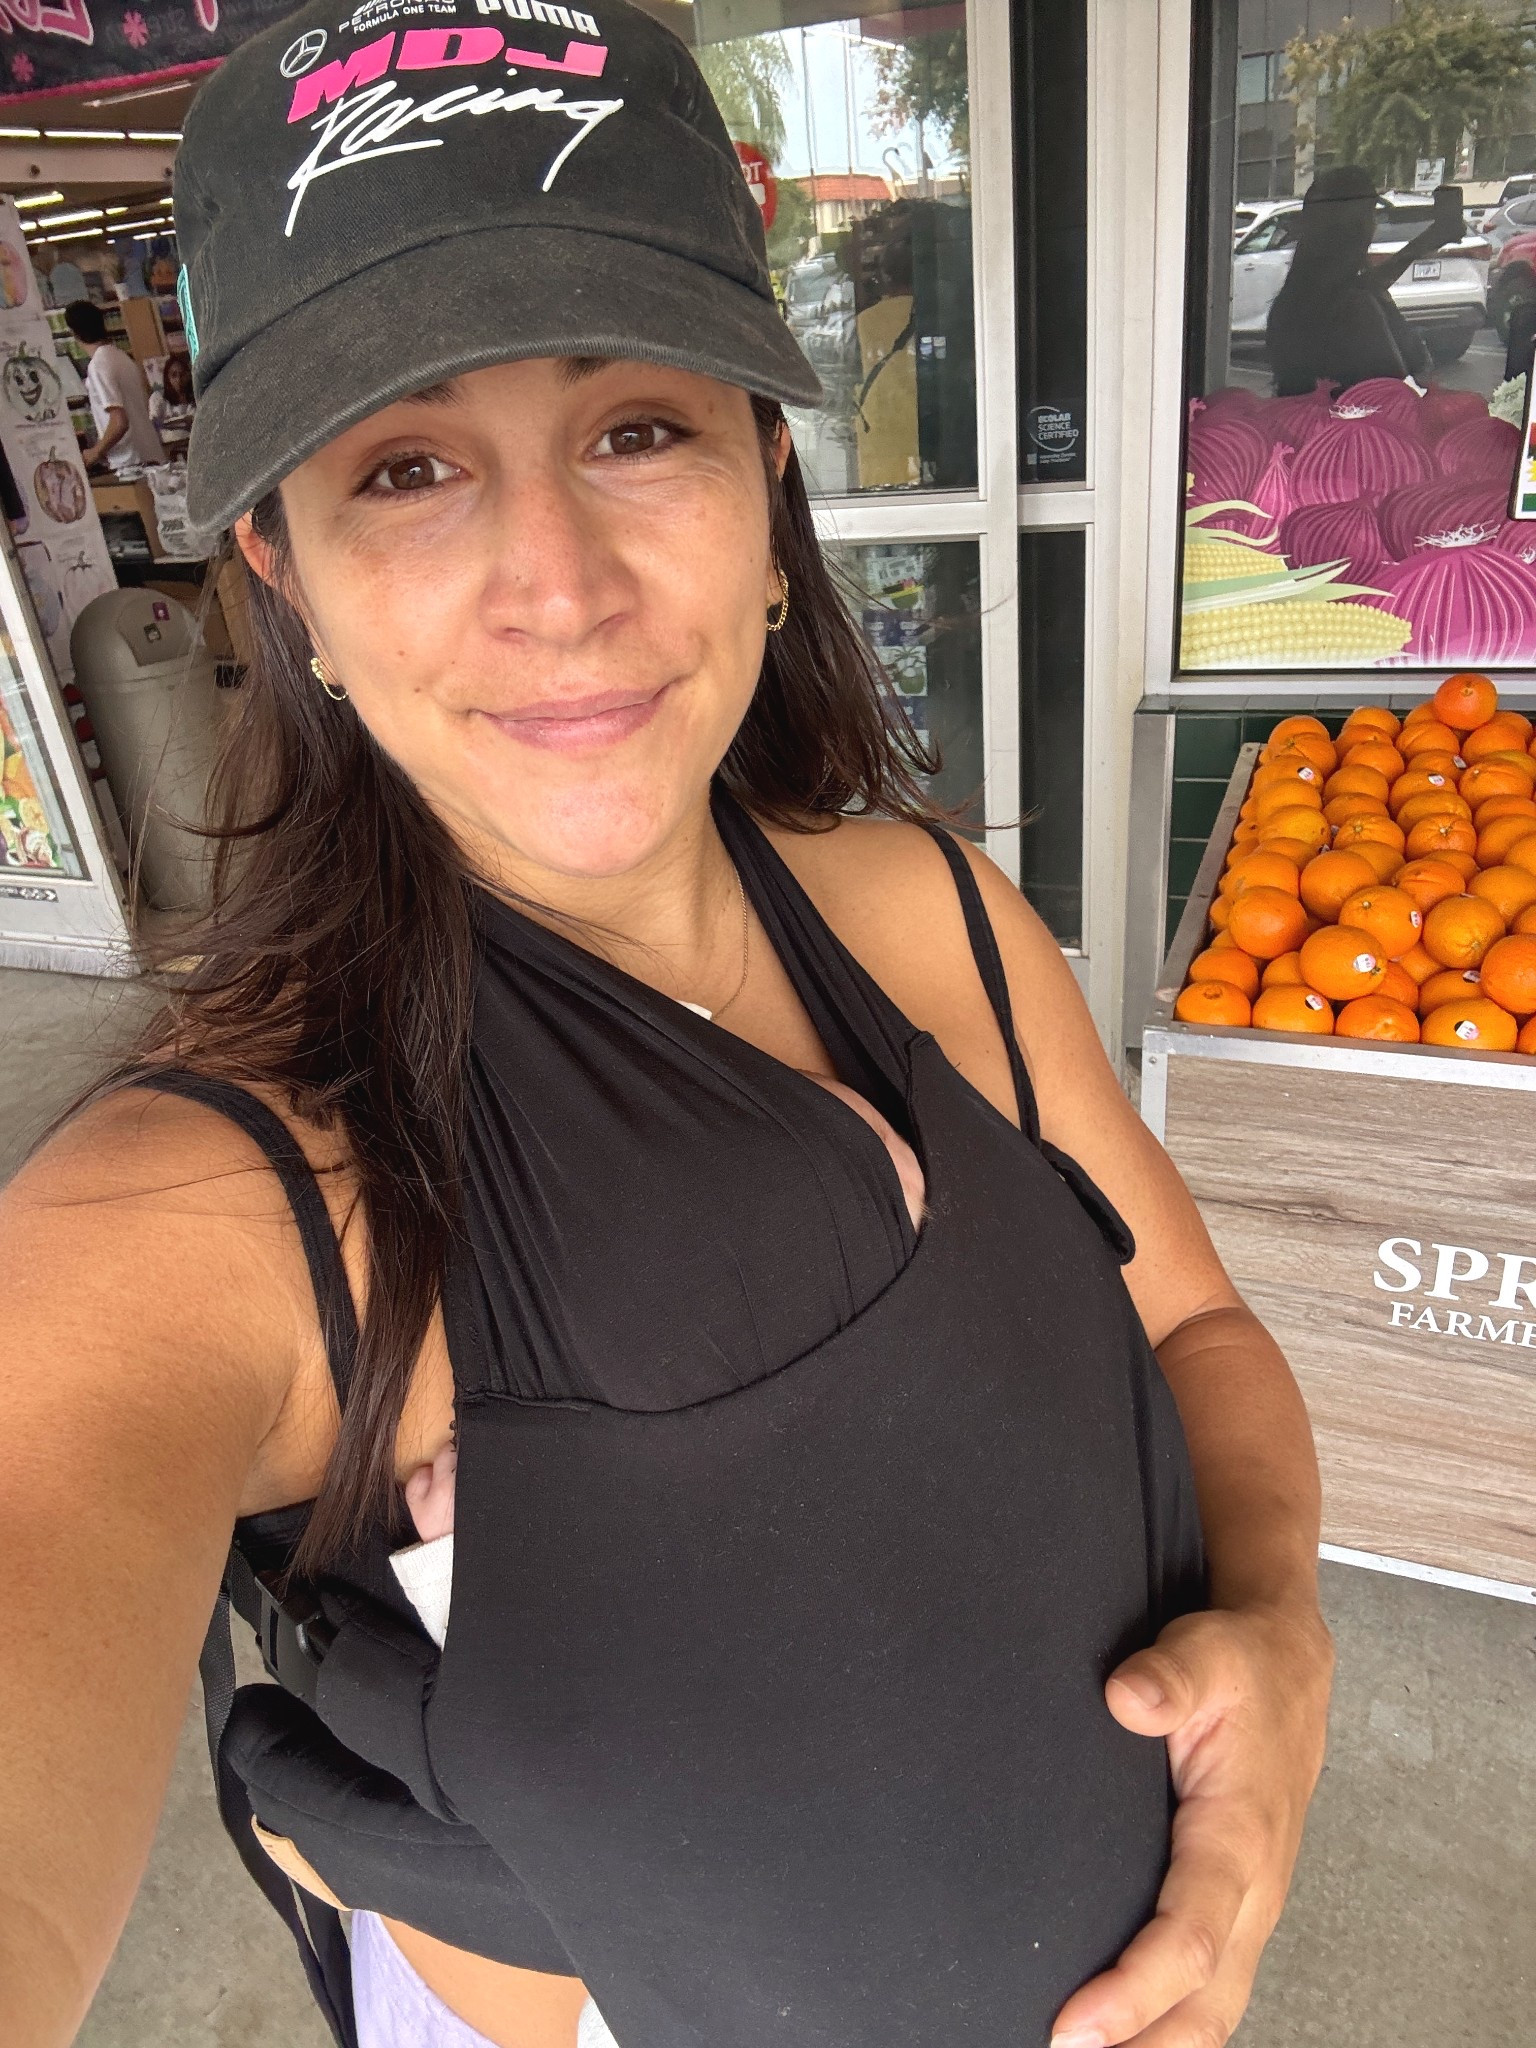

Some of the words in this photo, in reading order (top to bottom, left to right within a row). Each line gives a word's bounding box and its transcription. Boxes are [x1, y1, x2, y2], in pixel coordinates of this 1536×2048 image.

[338, 0, 455, 33] PETRO
[353, 10, 399, 35] FORMULA
[402, 5, 425, 15] ONE
[428, 4, 457, 14] TEAM
[475, 0, 601, 37] PUMA
[287, 27, 609, 124] MDJ
[284, 68, 624, 237] Racing
[741, 162, 762, 183] OT
[1038, 413, 1071, 422] ECOLAB
[1038, 422, 1070, 431] SCIENCE
[1038, 429, 1079, 440] CERTIFIED
[1373, 1237, 1536, 1311] SPR
[1387, 1301, 1536, 1349] FARME
